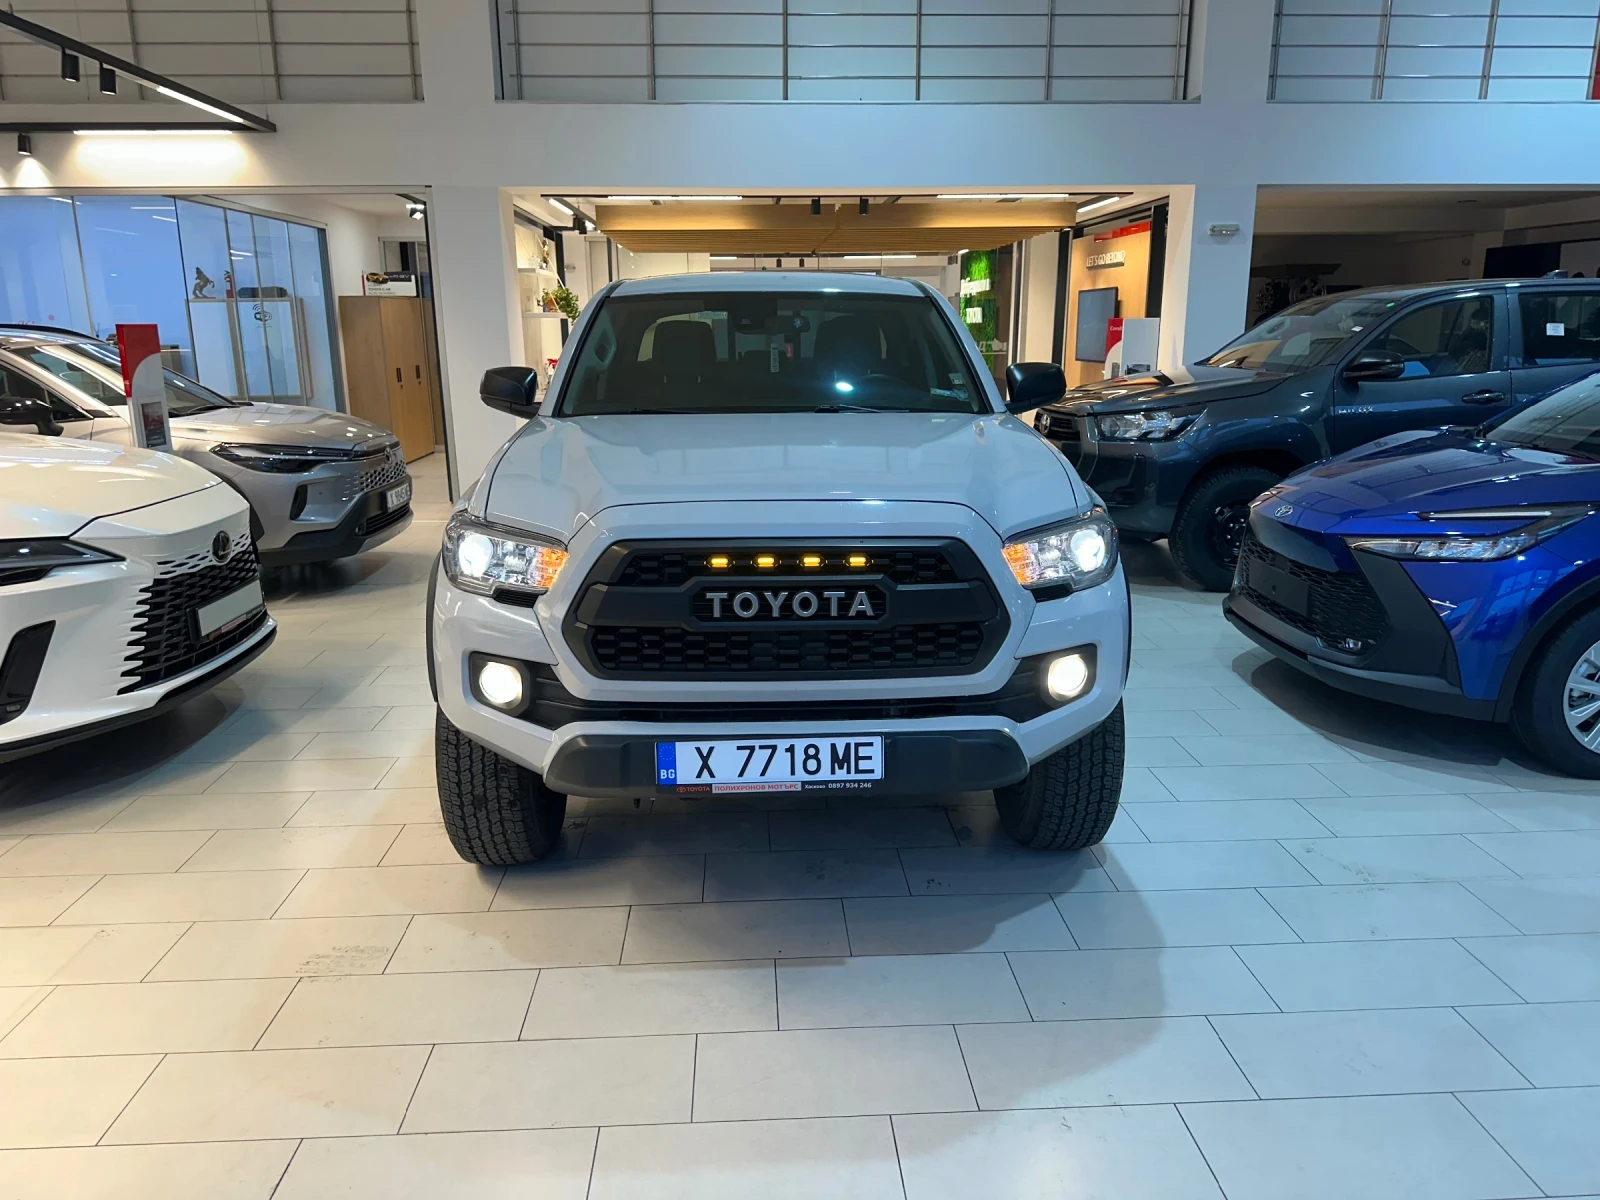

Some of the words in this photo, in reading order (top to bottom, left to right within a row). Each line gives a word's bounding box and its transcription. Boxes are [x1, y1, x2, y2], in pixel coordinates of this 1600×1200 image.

[1086, 256, 1098, 267] LET'S
[1098, 253, 1106, 265] GO
[706, 591, 875, 618] TOYOTA
[695, 746, 716, 779] X
[660, 769, 676, 779] BG
